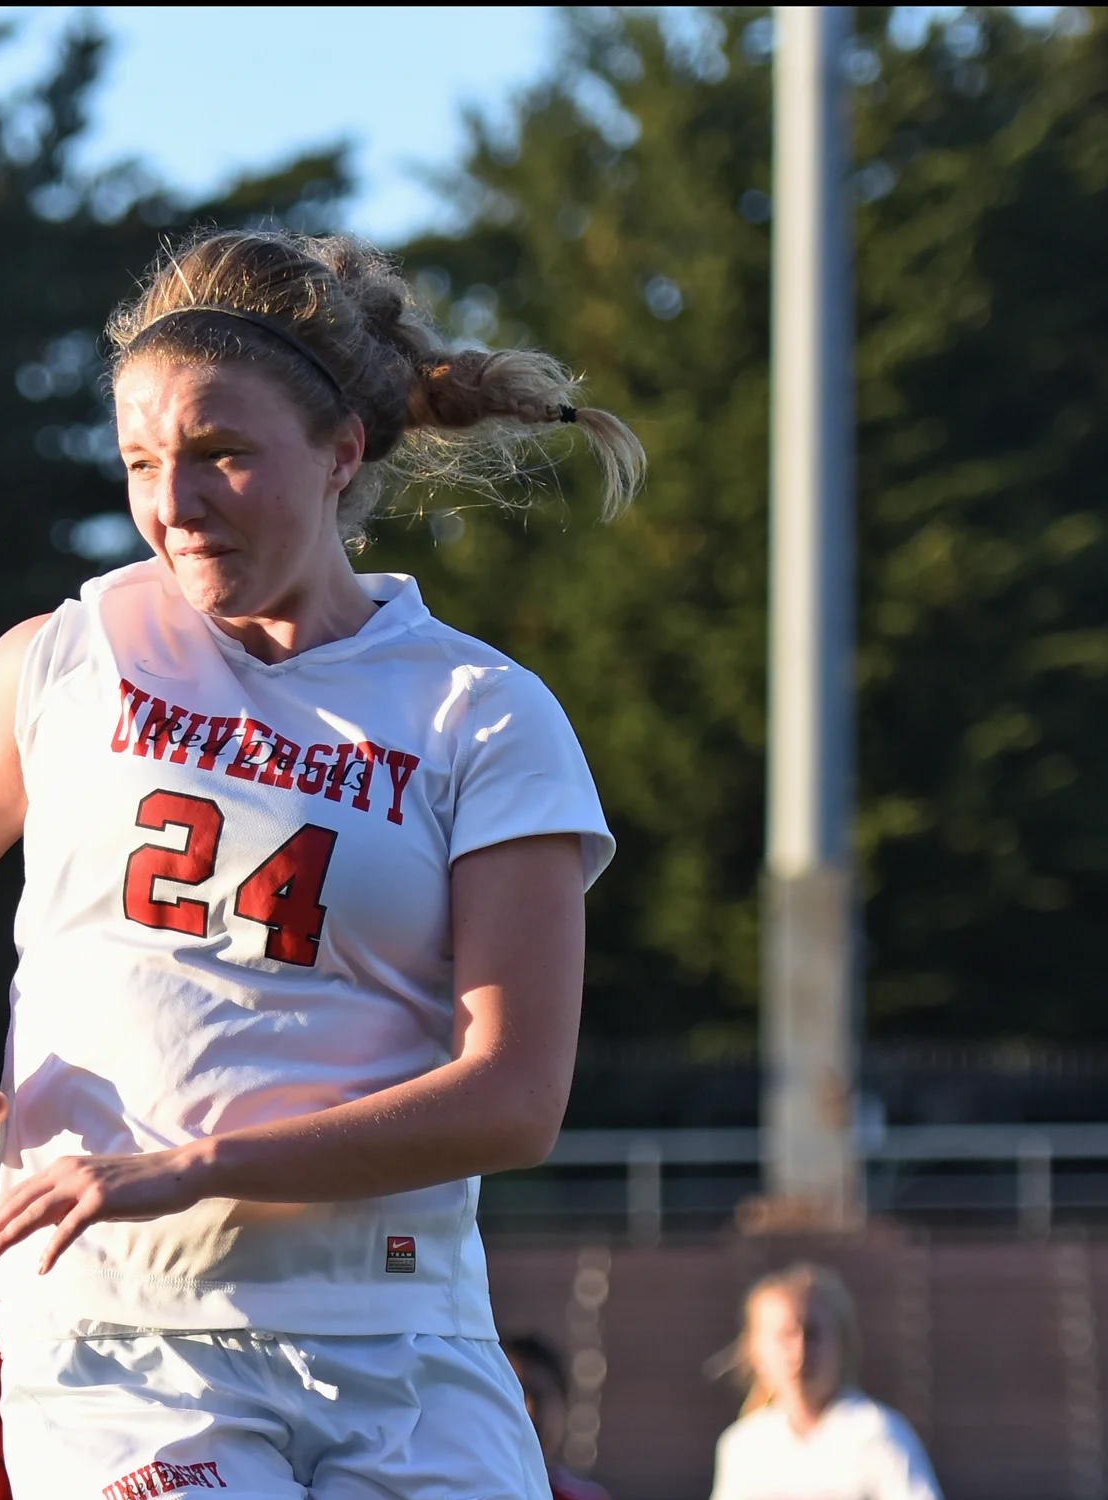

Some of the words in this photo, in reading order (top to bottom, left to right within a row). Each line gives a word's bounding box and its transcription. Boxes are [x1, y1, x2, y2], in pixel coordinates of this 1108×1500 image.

[111, 678, 420, 826] UNIVERSITY
[147, 717, 243, 757] Red
[242, 740, 370, 790] Devils
[122, 788, 339, 968] 24
